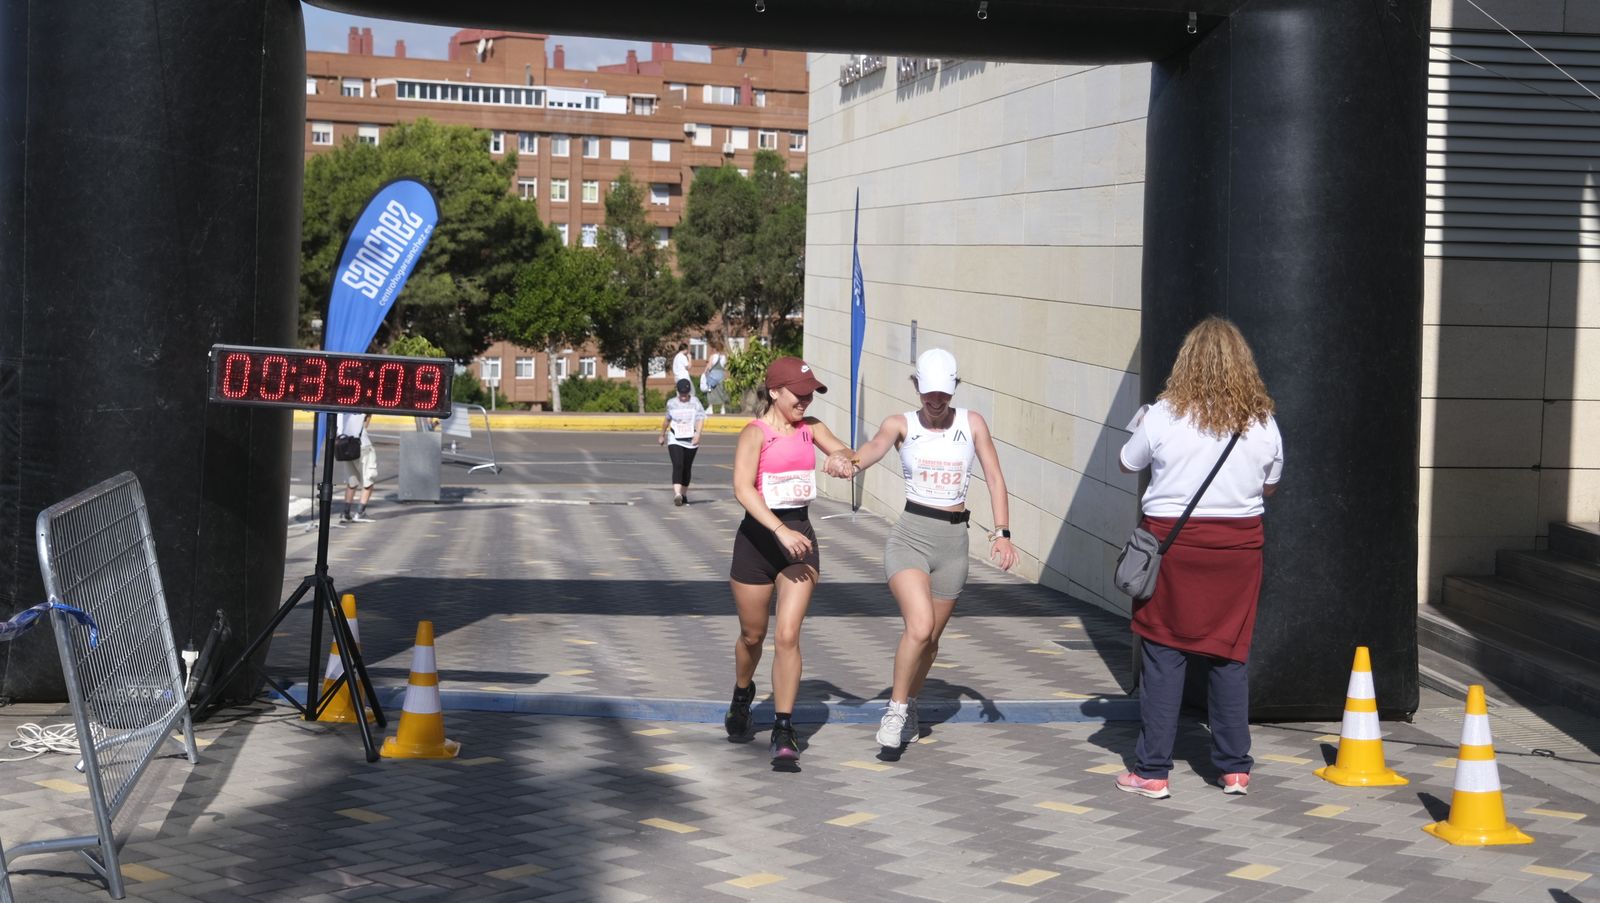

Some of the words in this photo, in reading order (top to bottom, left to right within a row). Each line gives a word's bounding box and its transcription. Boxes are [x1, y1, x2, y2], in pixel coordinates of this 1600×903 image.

[223, 353, 441, 409] 00:35:09
[919, 471, 962, 485] 1182
[771, 484, 812, 498] 169
